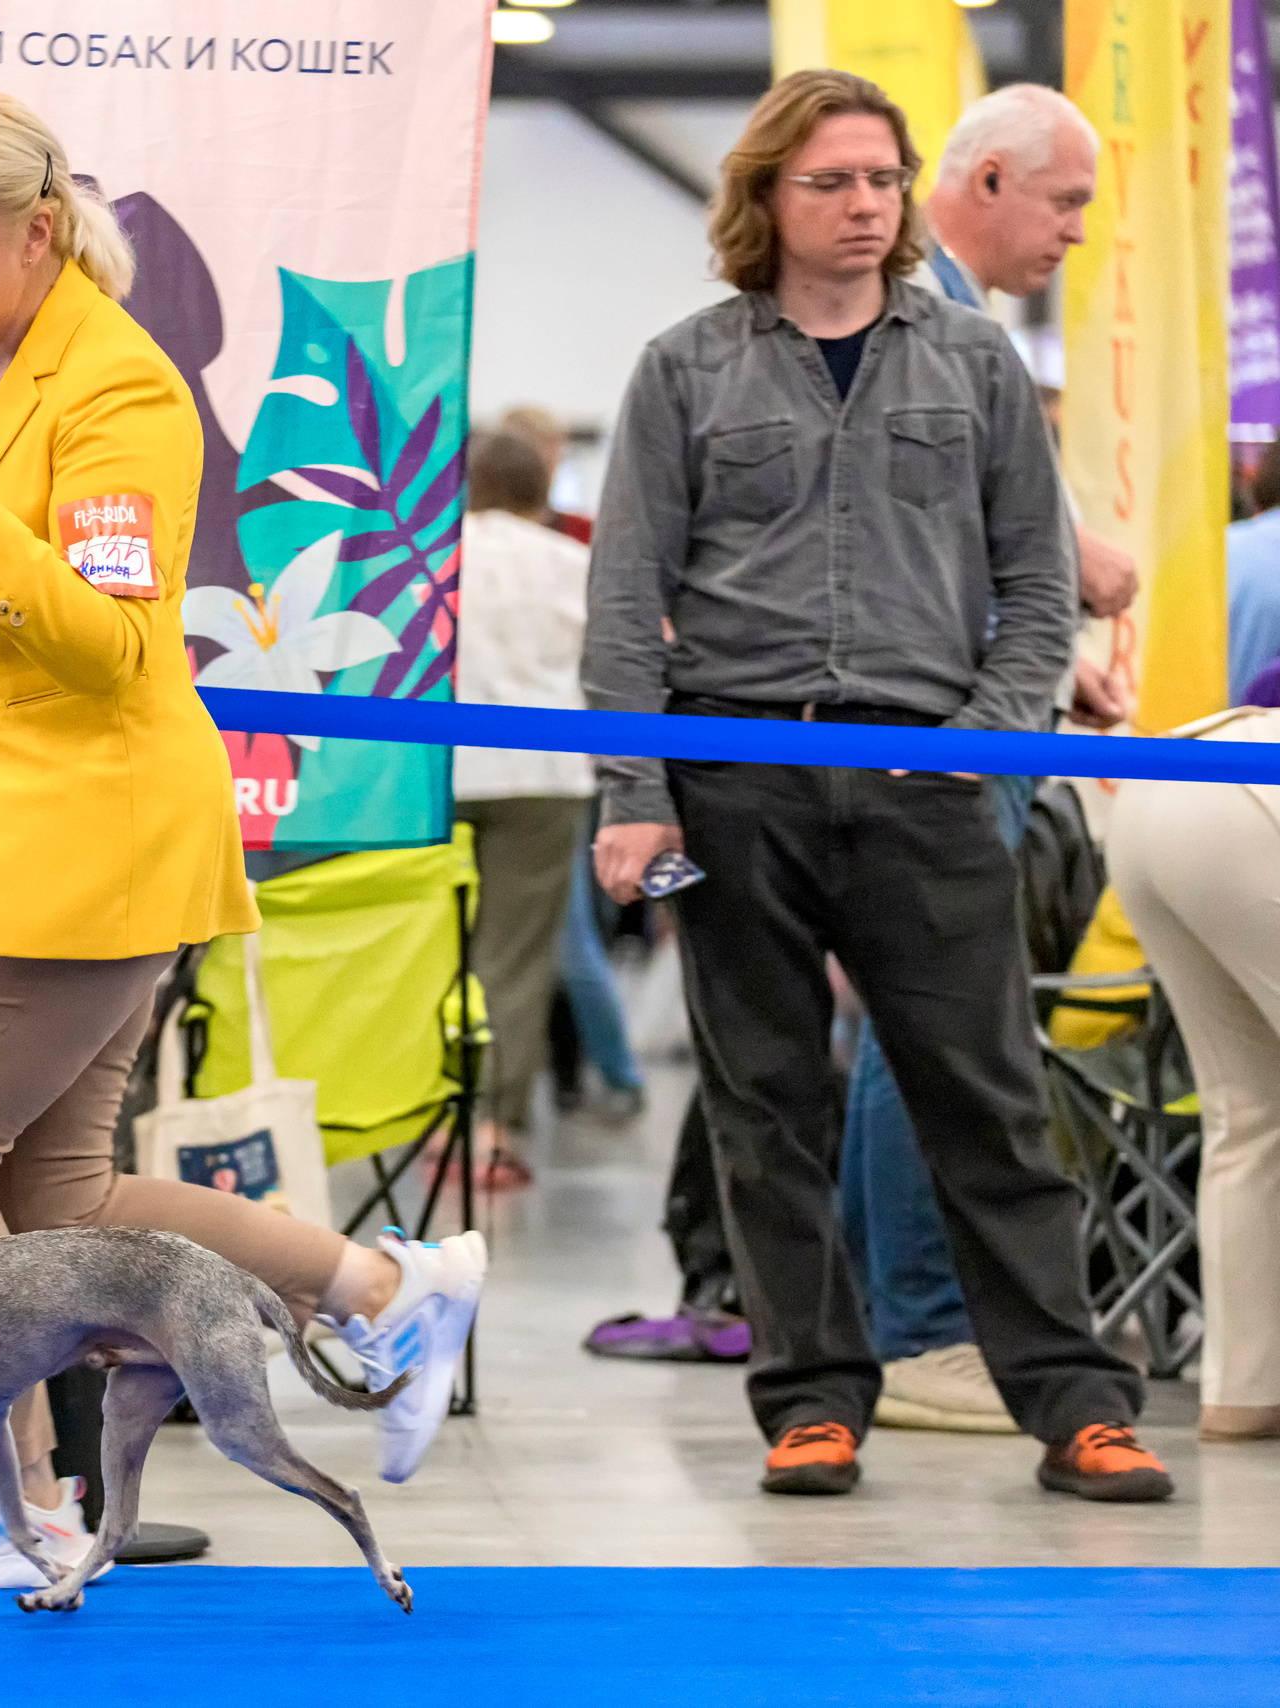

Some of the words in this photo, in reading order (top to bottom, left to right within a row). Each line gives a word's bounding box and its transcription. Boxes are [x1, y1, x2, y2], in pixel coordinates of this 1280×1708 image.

[19, 31, 173, 69] СОБАК
[185, 36, 216, 71] И
[229, 37, 396, 75] КОШЕК
[73, 505, 138, 529] FLORIDA
